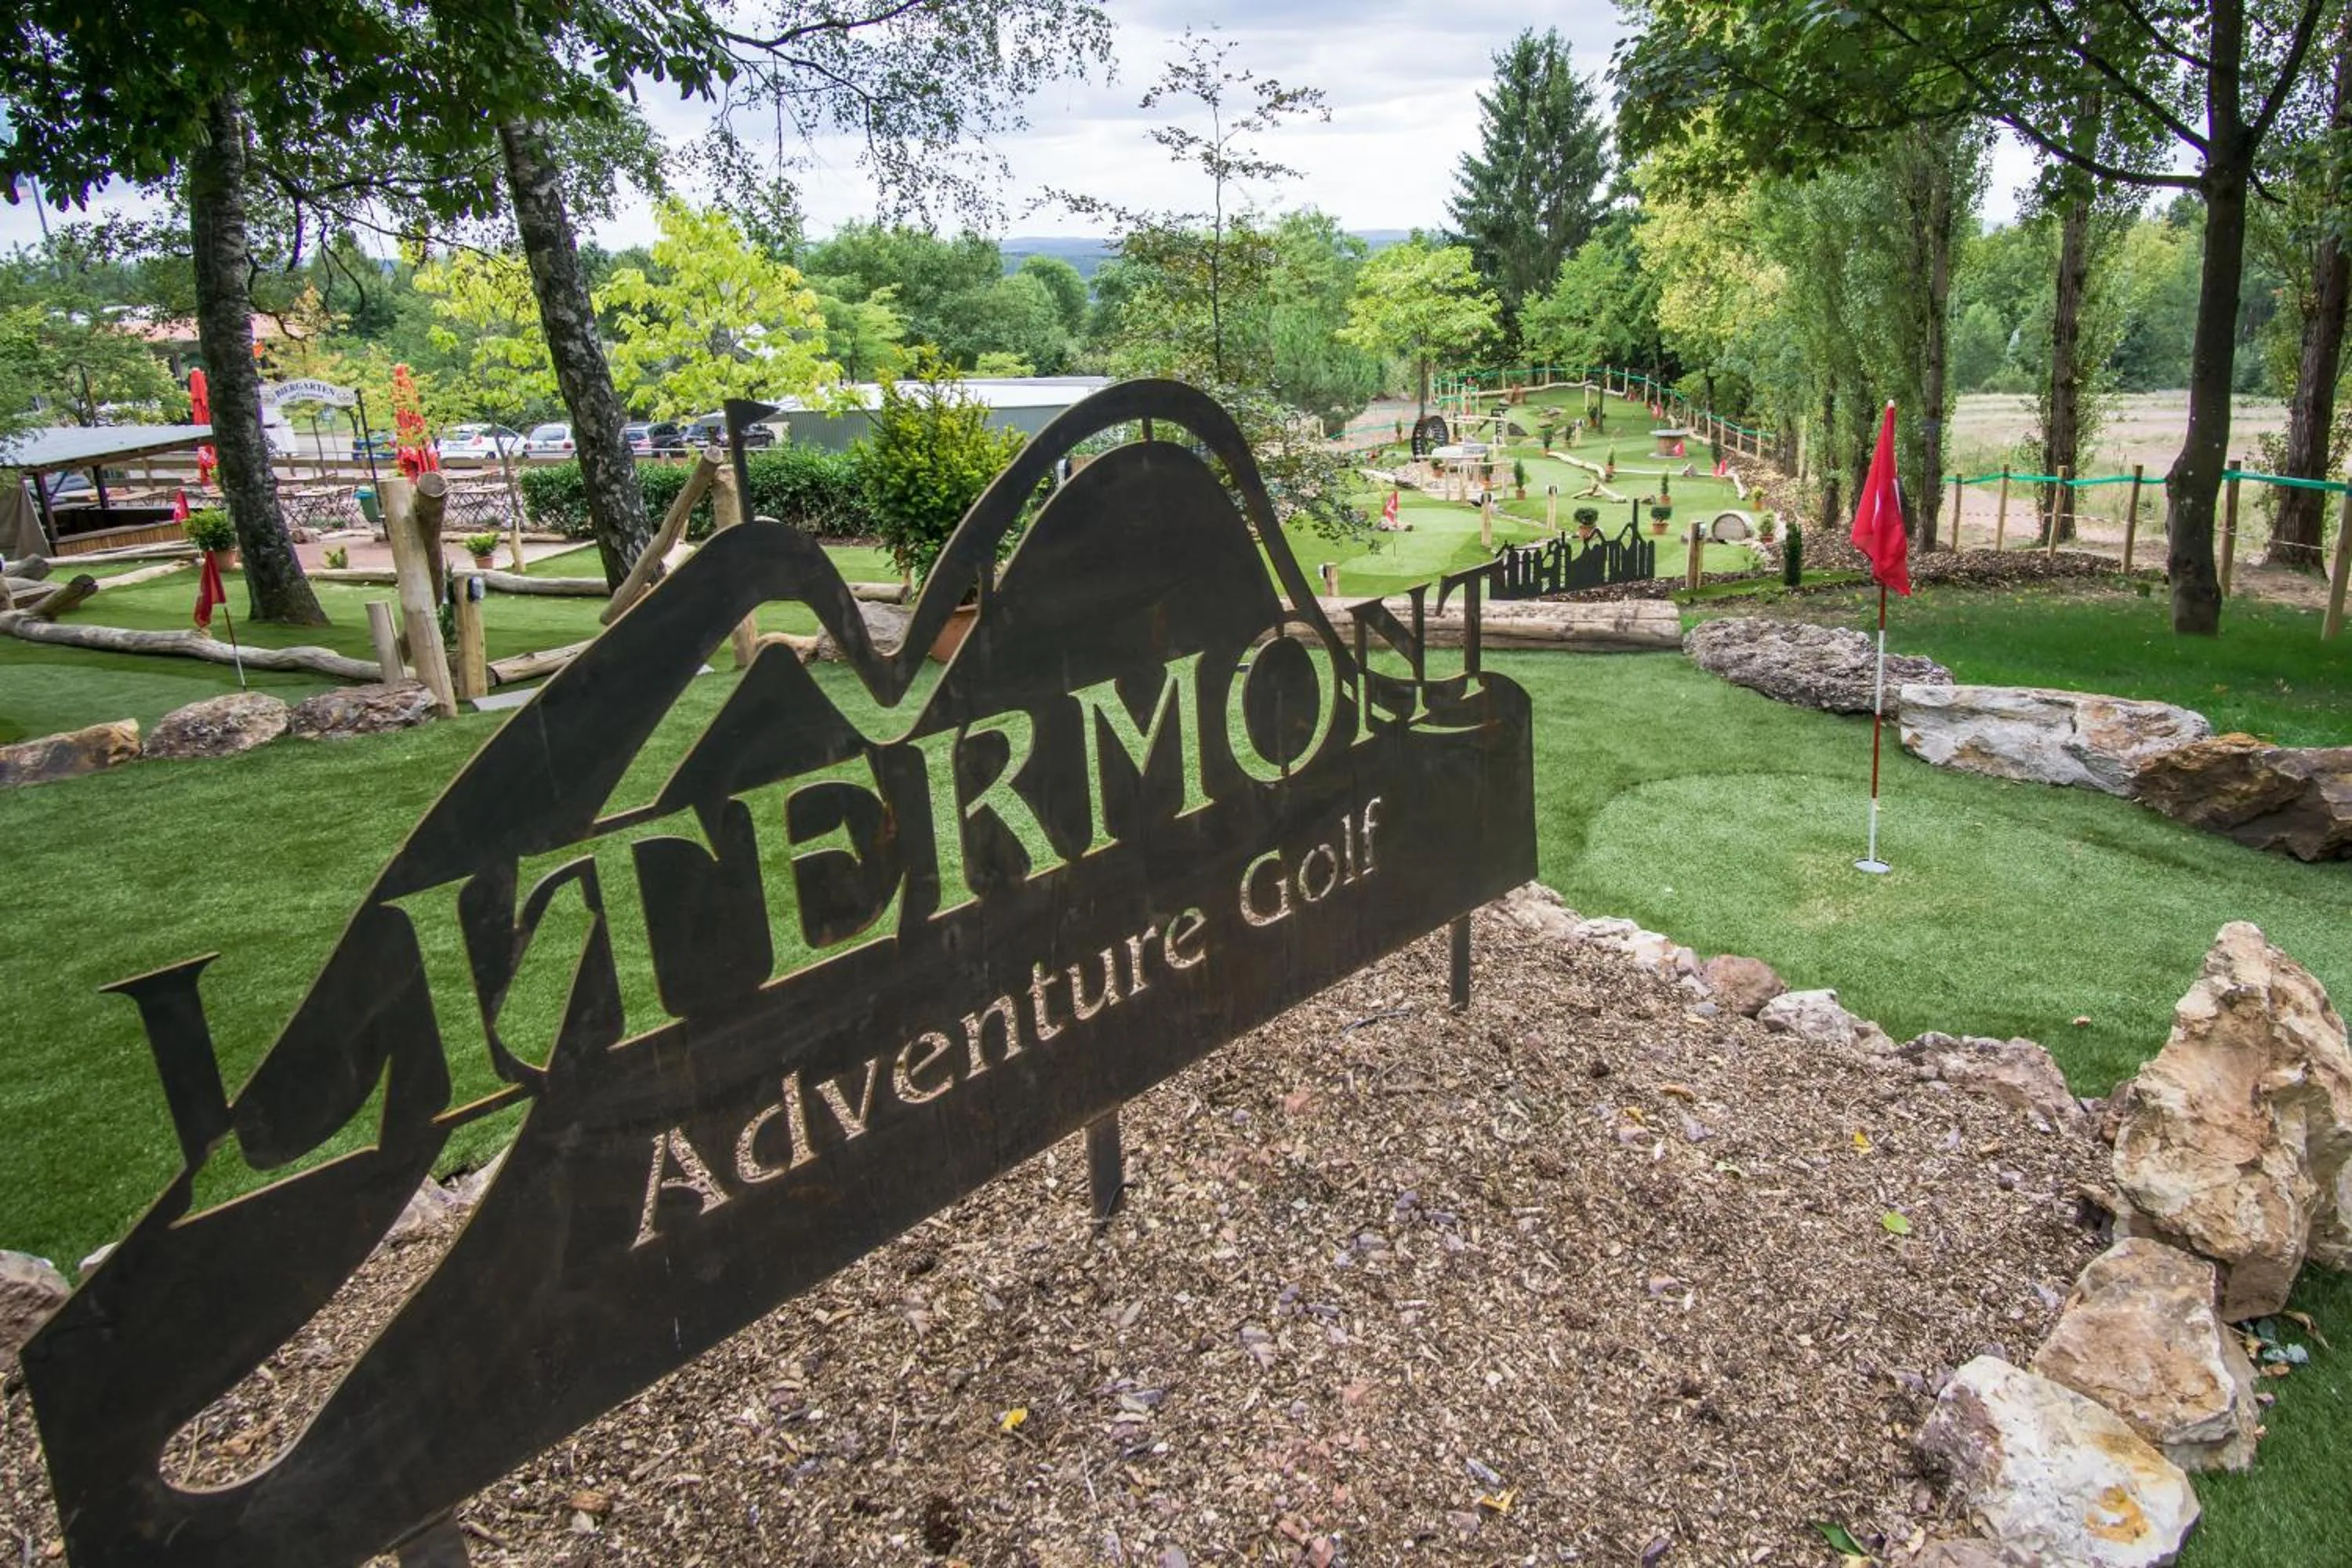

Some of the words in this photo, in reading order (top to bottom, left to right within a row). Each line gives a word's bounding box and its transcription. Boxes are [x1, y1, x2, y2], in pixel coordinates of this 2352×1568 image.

[274, 382, 335, 397] BIERGARTEN
[99, 560, 1502, 1229] LITERMONT
[630, 906, 1206, 1250] Adventure
[1239, 795, 1384, 927] Golf
